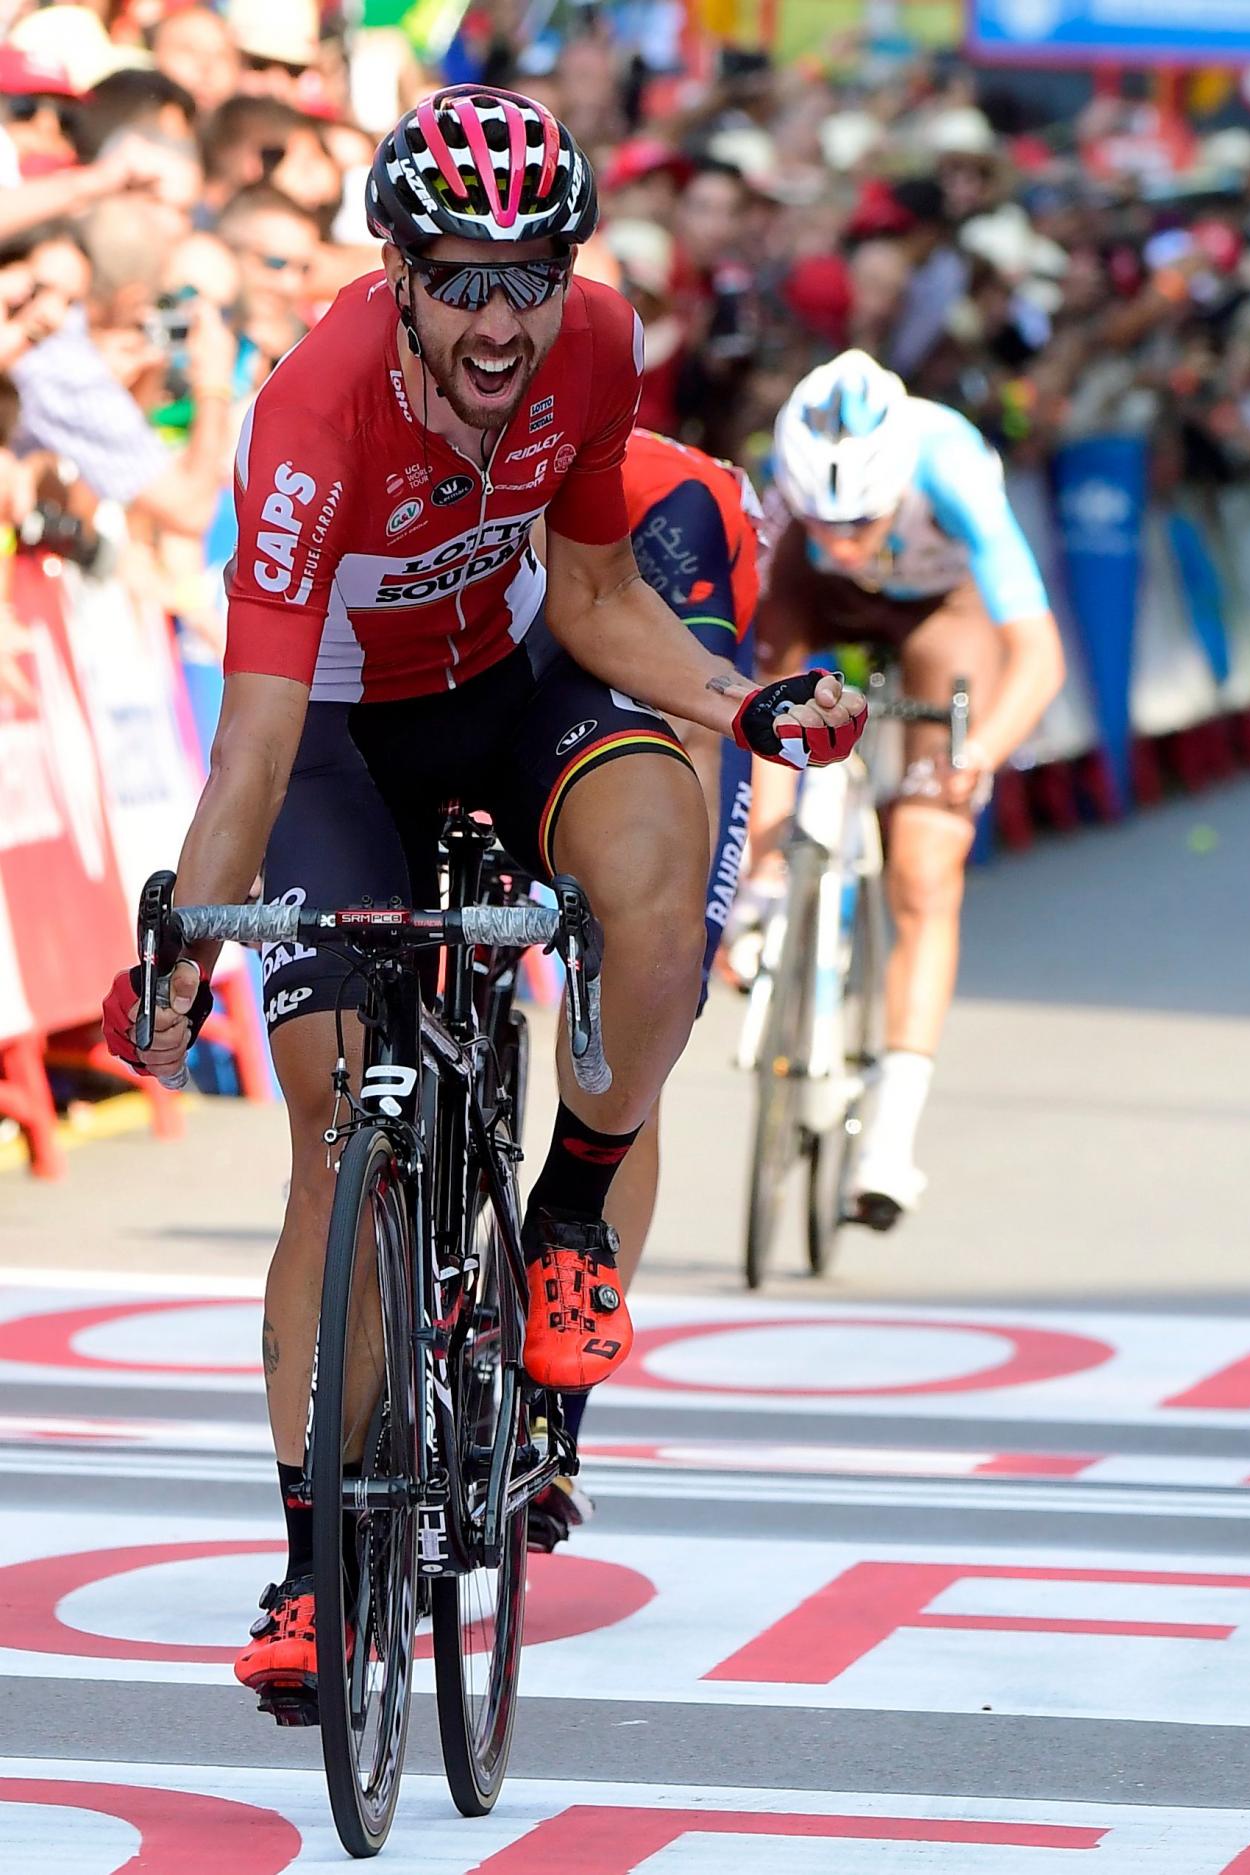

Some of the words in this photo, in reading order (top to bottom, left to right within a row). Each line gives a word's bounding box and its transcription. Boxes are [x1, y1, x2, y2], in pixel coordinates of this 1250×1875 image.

[399, 158, 439, 214] LAZER
[531, 397, 553, 415] LOTTO
[504, 431, 565, 463] RIDLEY
[405, 463, 420, 475] UCI
[408, 475, 429, 489] TOUR
[254, 463, 316, 592] CAPS
[312, 505, 334, 544] CARD
[375, 535, 524, 602] SOUDA
[705, 780, 752, 927] BAHRAIN
[341, 913, 371, 924] SRM
